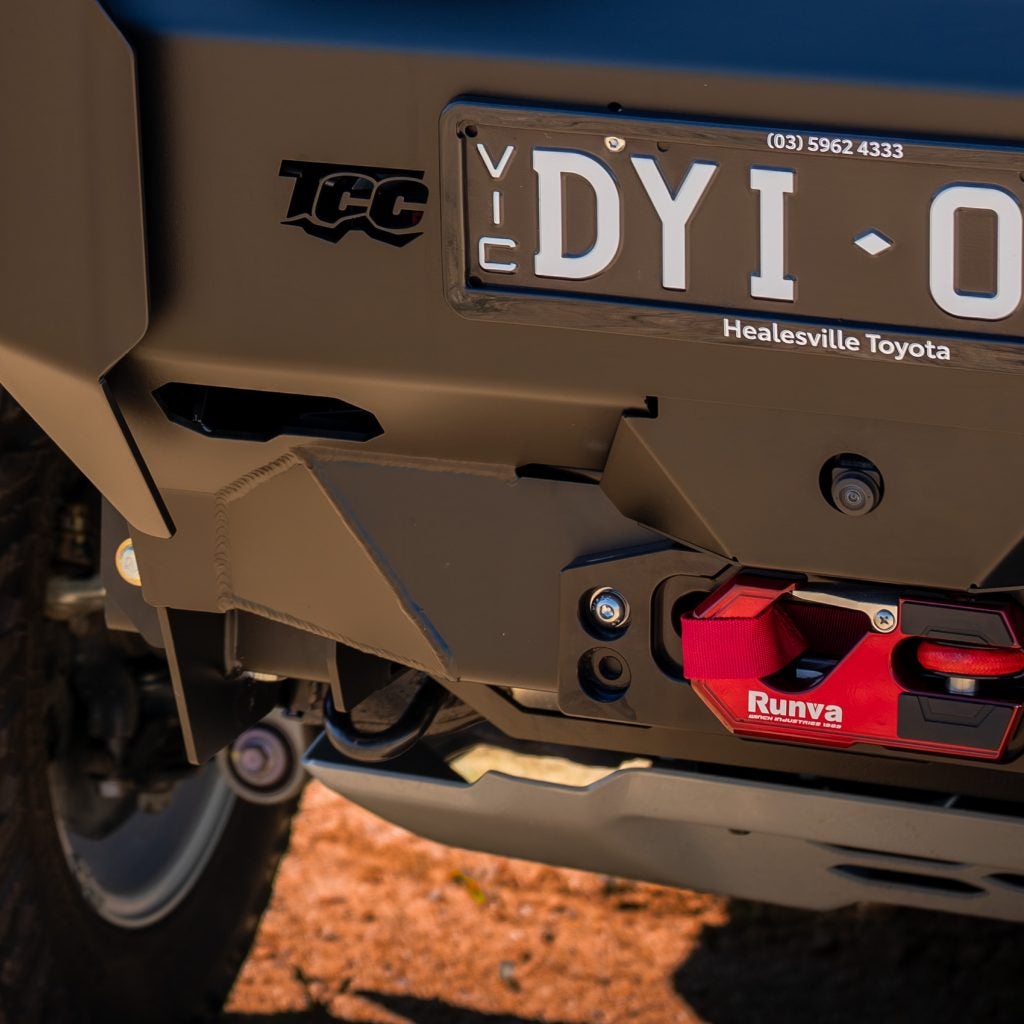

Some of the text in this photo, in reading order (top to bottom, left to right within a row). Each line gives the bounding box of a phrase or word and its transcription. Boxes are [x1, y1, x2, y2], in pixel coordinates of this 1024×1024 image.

[766, 132, 904, 159] (03) 5962 4333
[279, 159, 430, 231] TCC
[476, 143, 517, 272] VIC
[532, 147, 796, 303] DYI
[723, 318, 951, 361] Healesville Toyota
[748, 690, 843, 723] Runva
